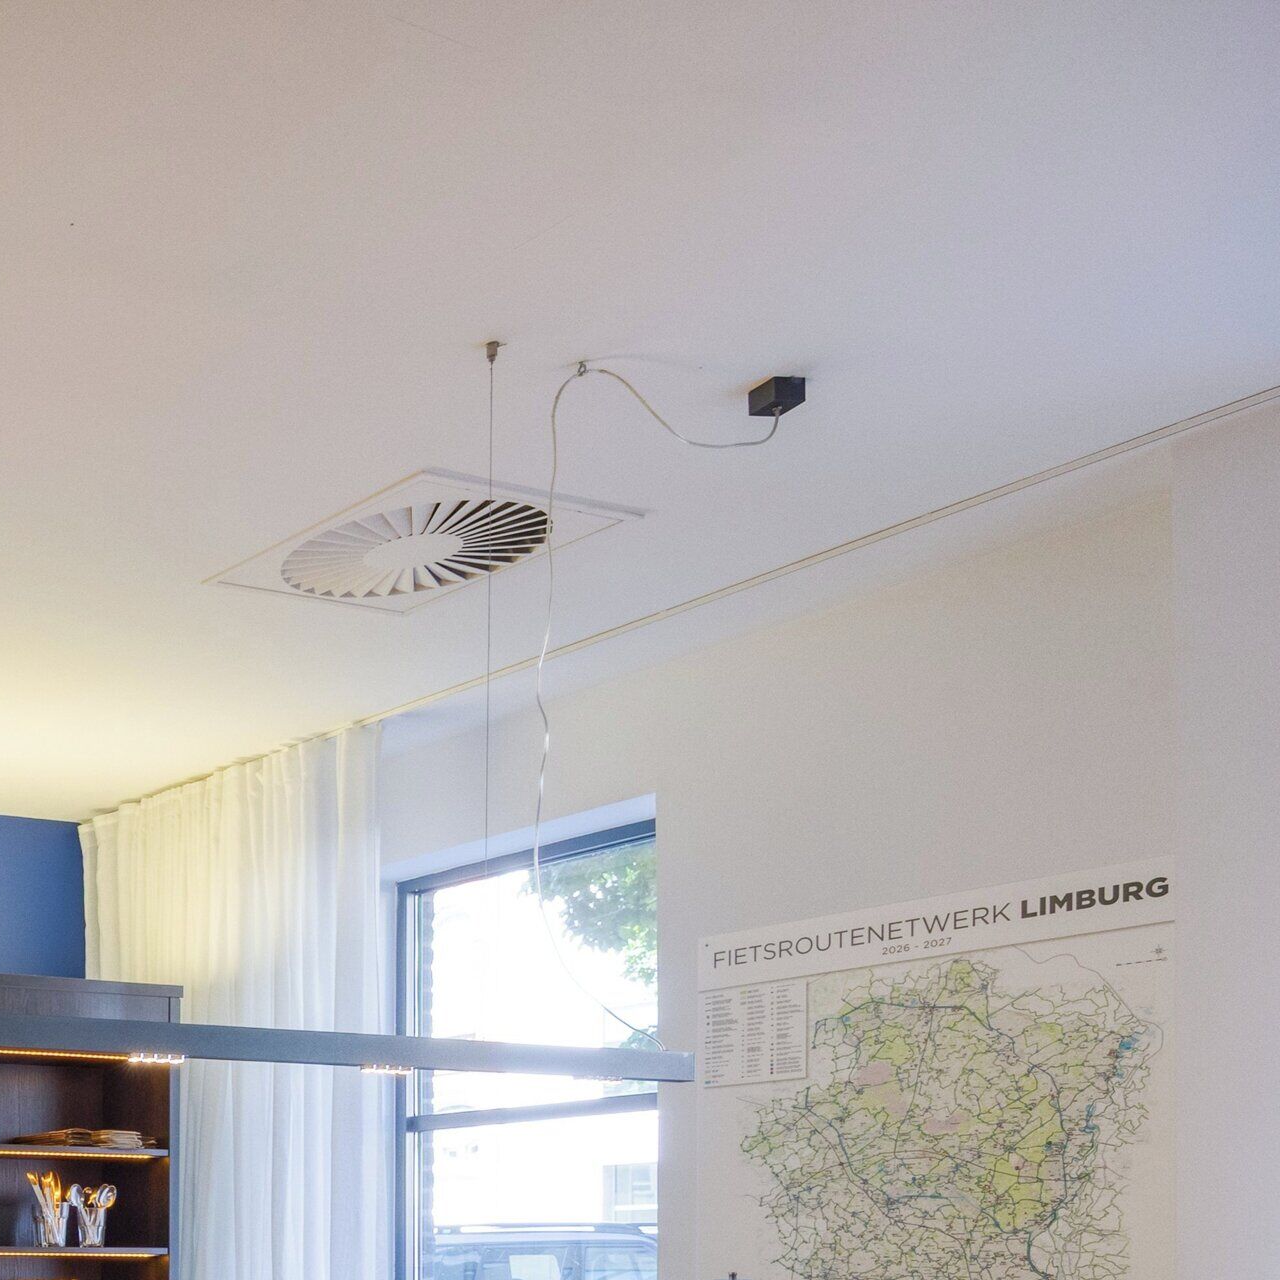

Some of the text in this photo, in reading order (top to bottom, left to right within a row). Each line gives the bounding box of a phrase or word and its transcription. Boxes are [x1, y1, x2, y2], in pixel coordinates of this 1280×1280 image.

[713, 876, 1170, 969] FIETSROUTENETWERK LIMBURG
[882, 943, 910, 956] 2026
[923, 937, 953, 950] 2027
